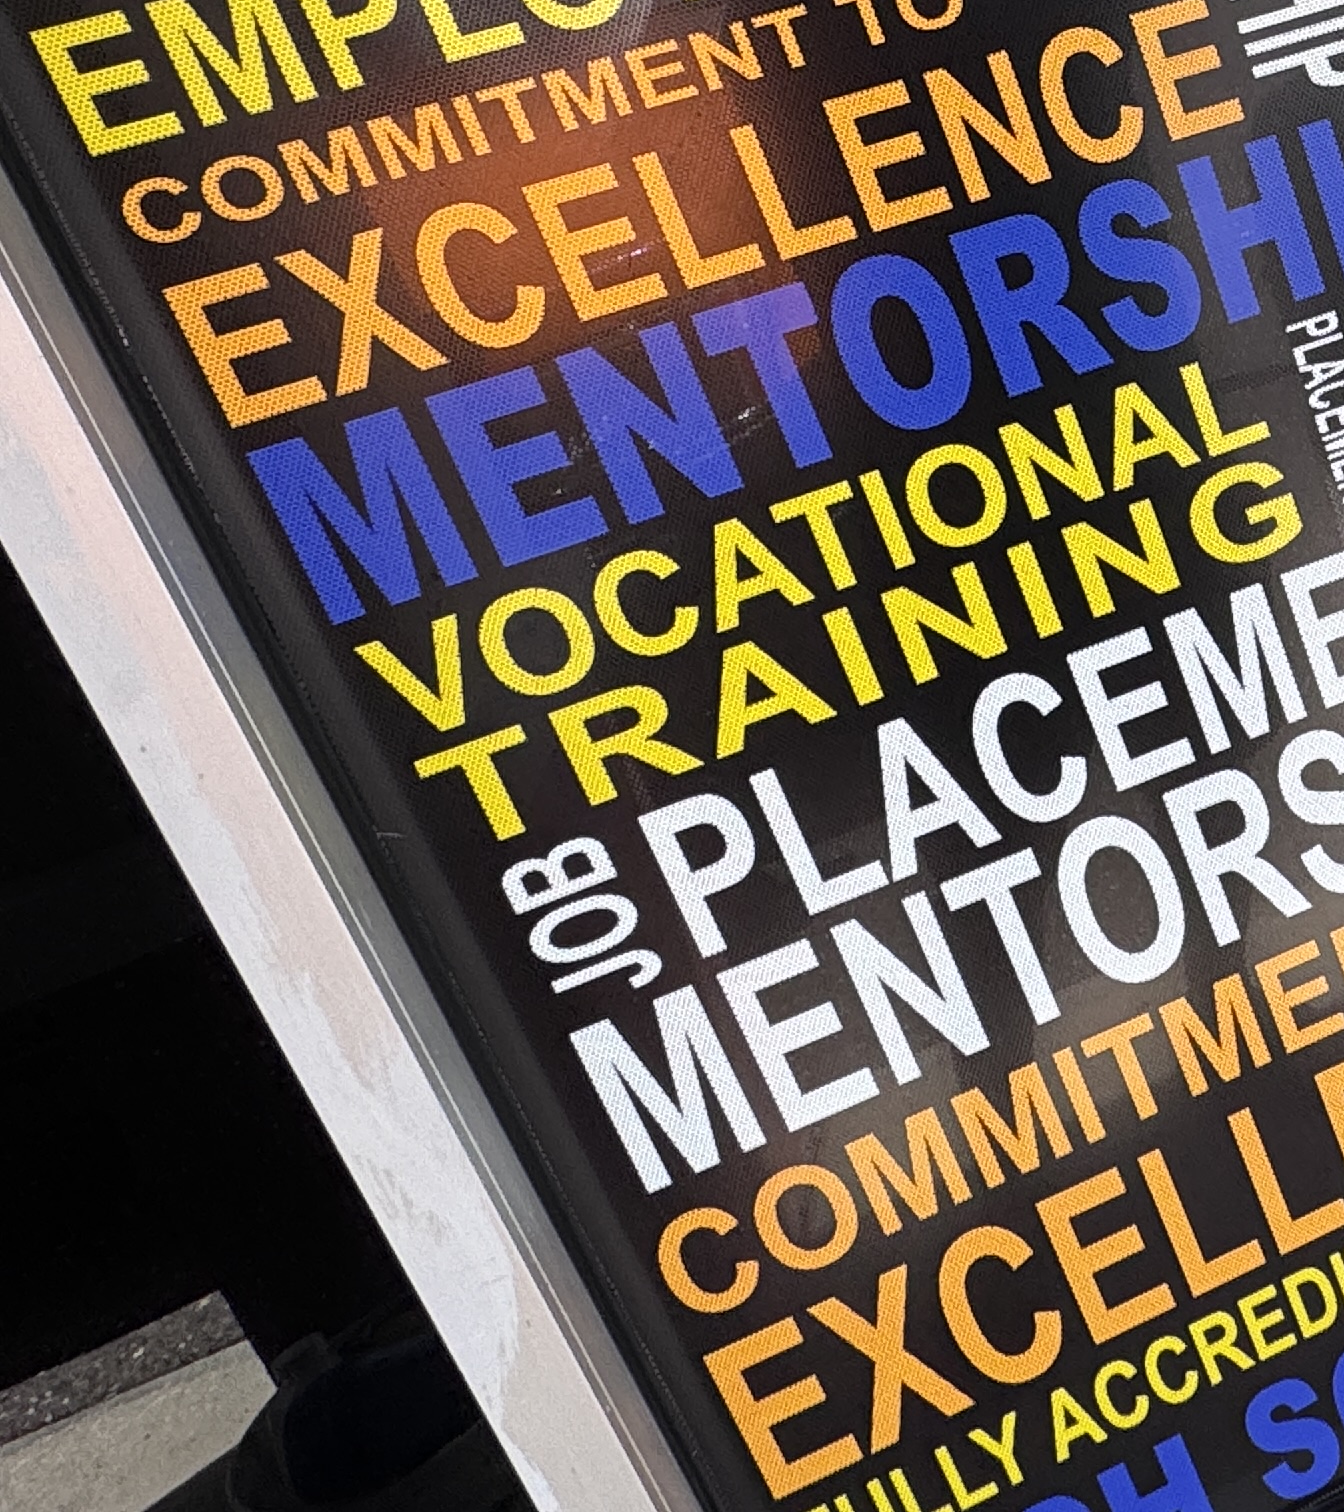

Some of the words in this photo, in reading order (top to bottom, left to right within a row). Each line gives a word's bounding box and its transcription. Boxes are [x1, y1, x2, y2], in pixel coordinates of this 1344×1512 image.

[121, 3, 808, 244] COMMITMENT
[355, 361, 1271, 733] VOCATIONAL
[414, 458, 1306, 841] TRAINING
[500, 835, 664, 995] JOB
[806, 1410, 1024, 1512] LLY
